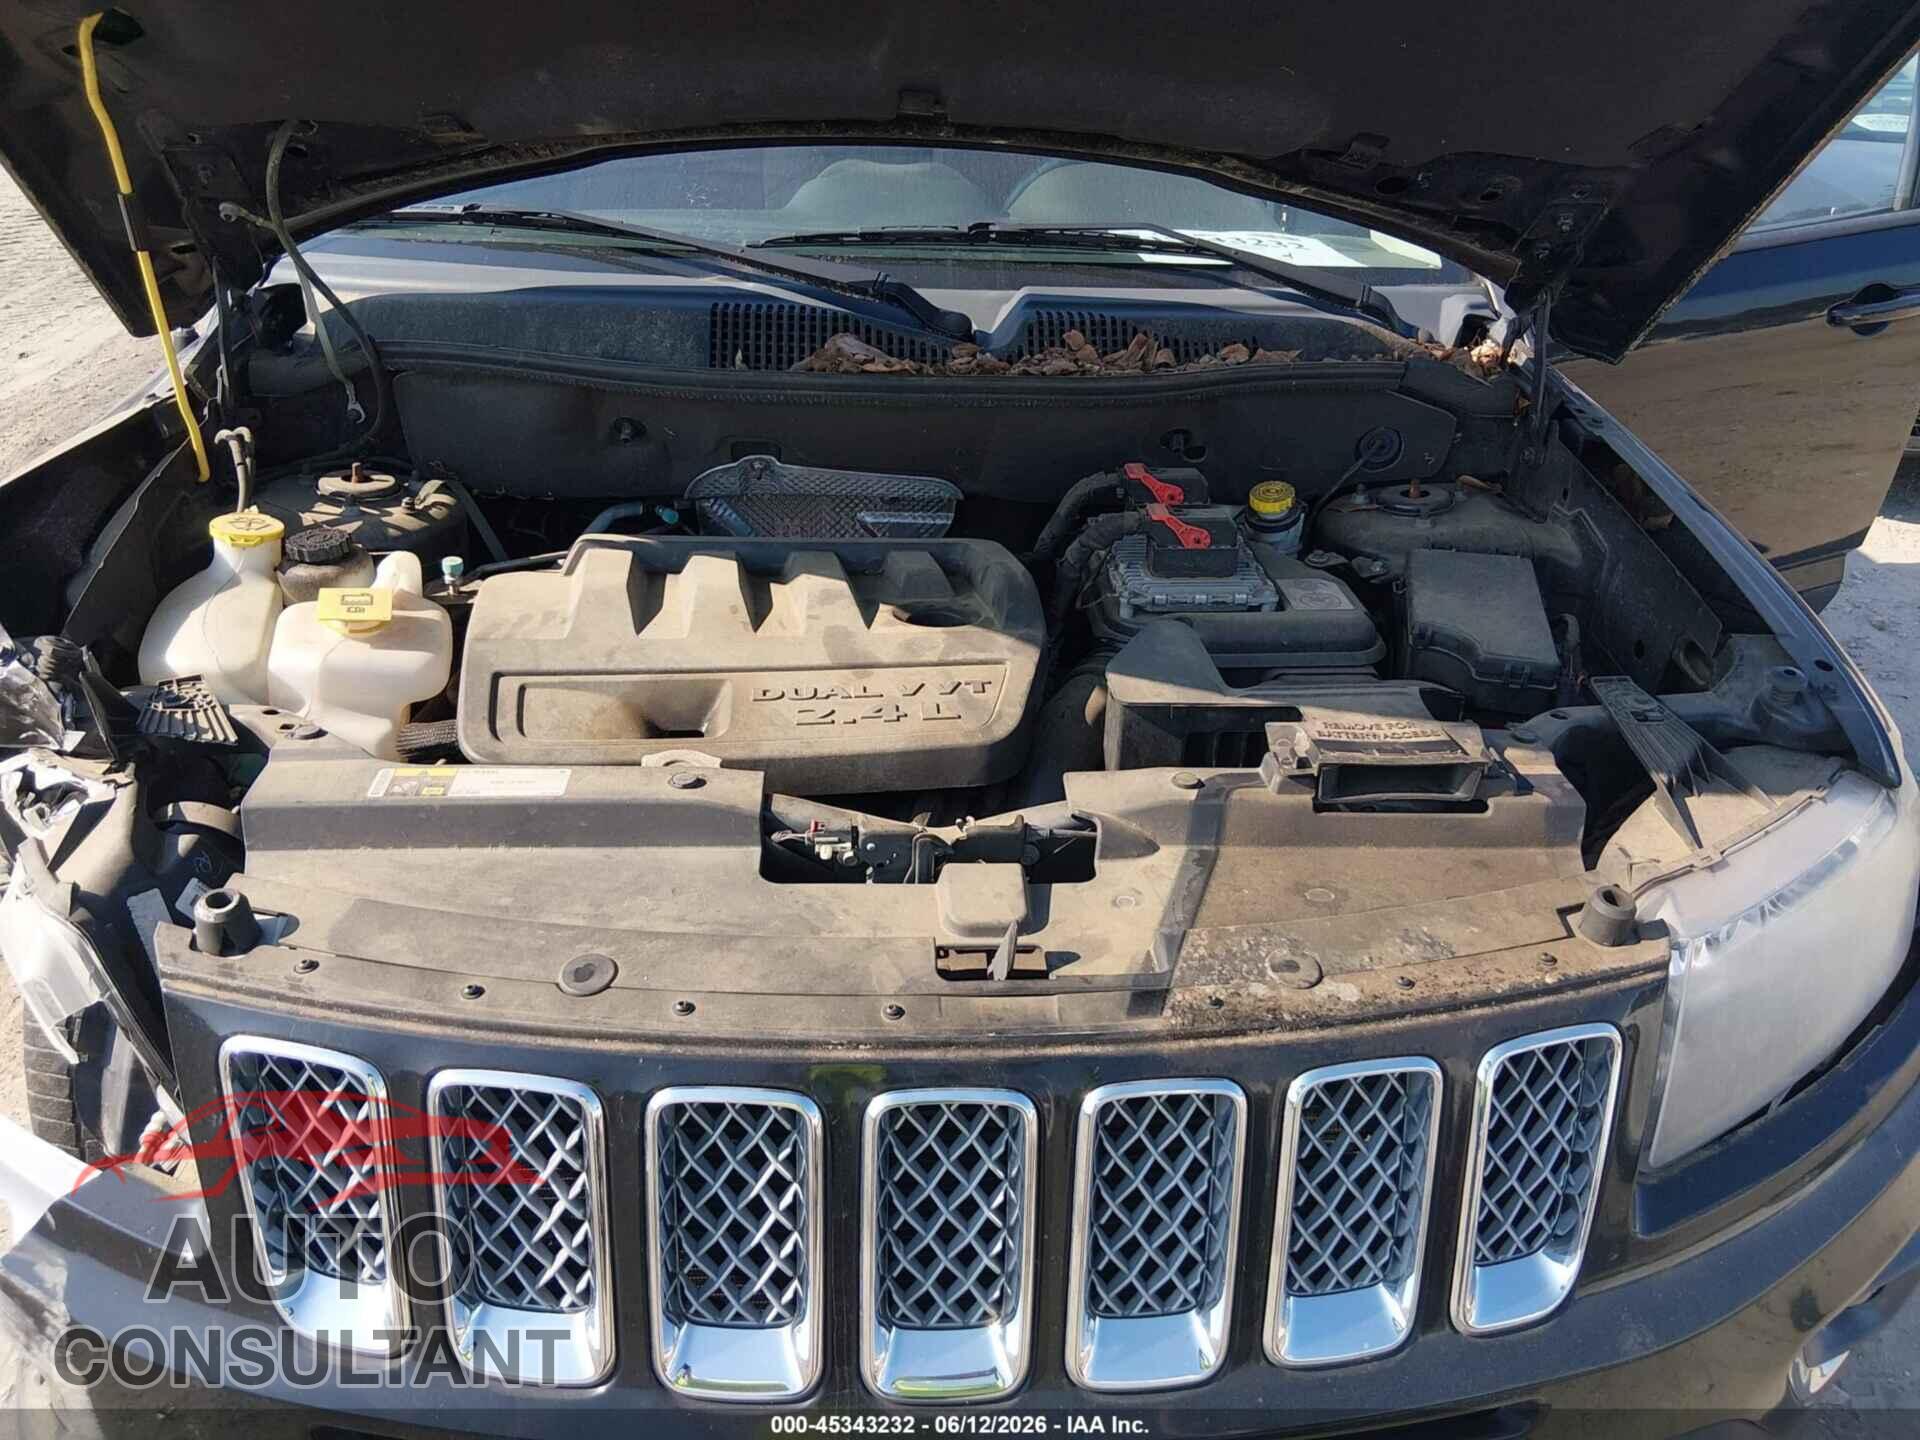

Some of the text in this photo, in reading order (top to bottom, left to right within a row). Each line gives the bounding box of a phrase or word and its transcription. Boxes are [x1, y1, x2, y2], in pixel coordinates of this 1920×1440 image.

[752, 681, 993, 702] DUAL VVT
[796, 703, 962, 726] 2.4L
